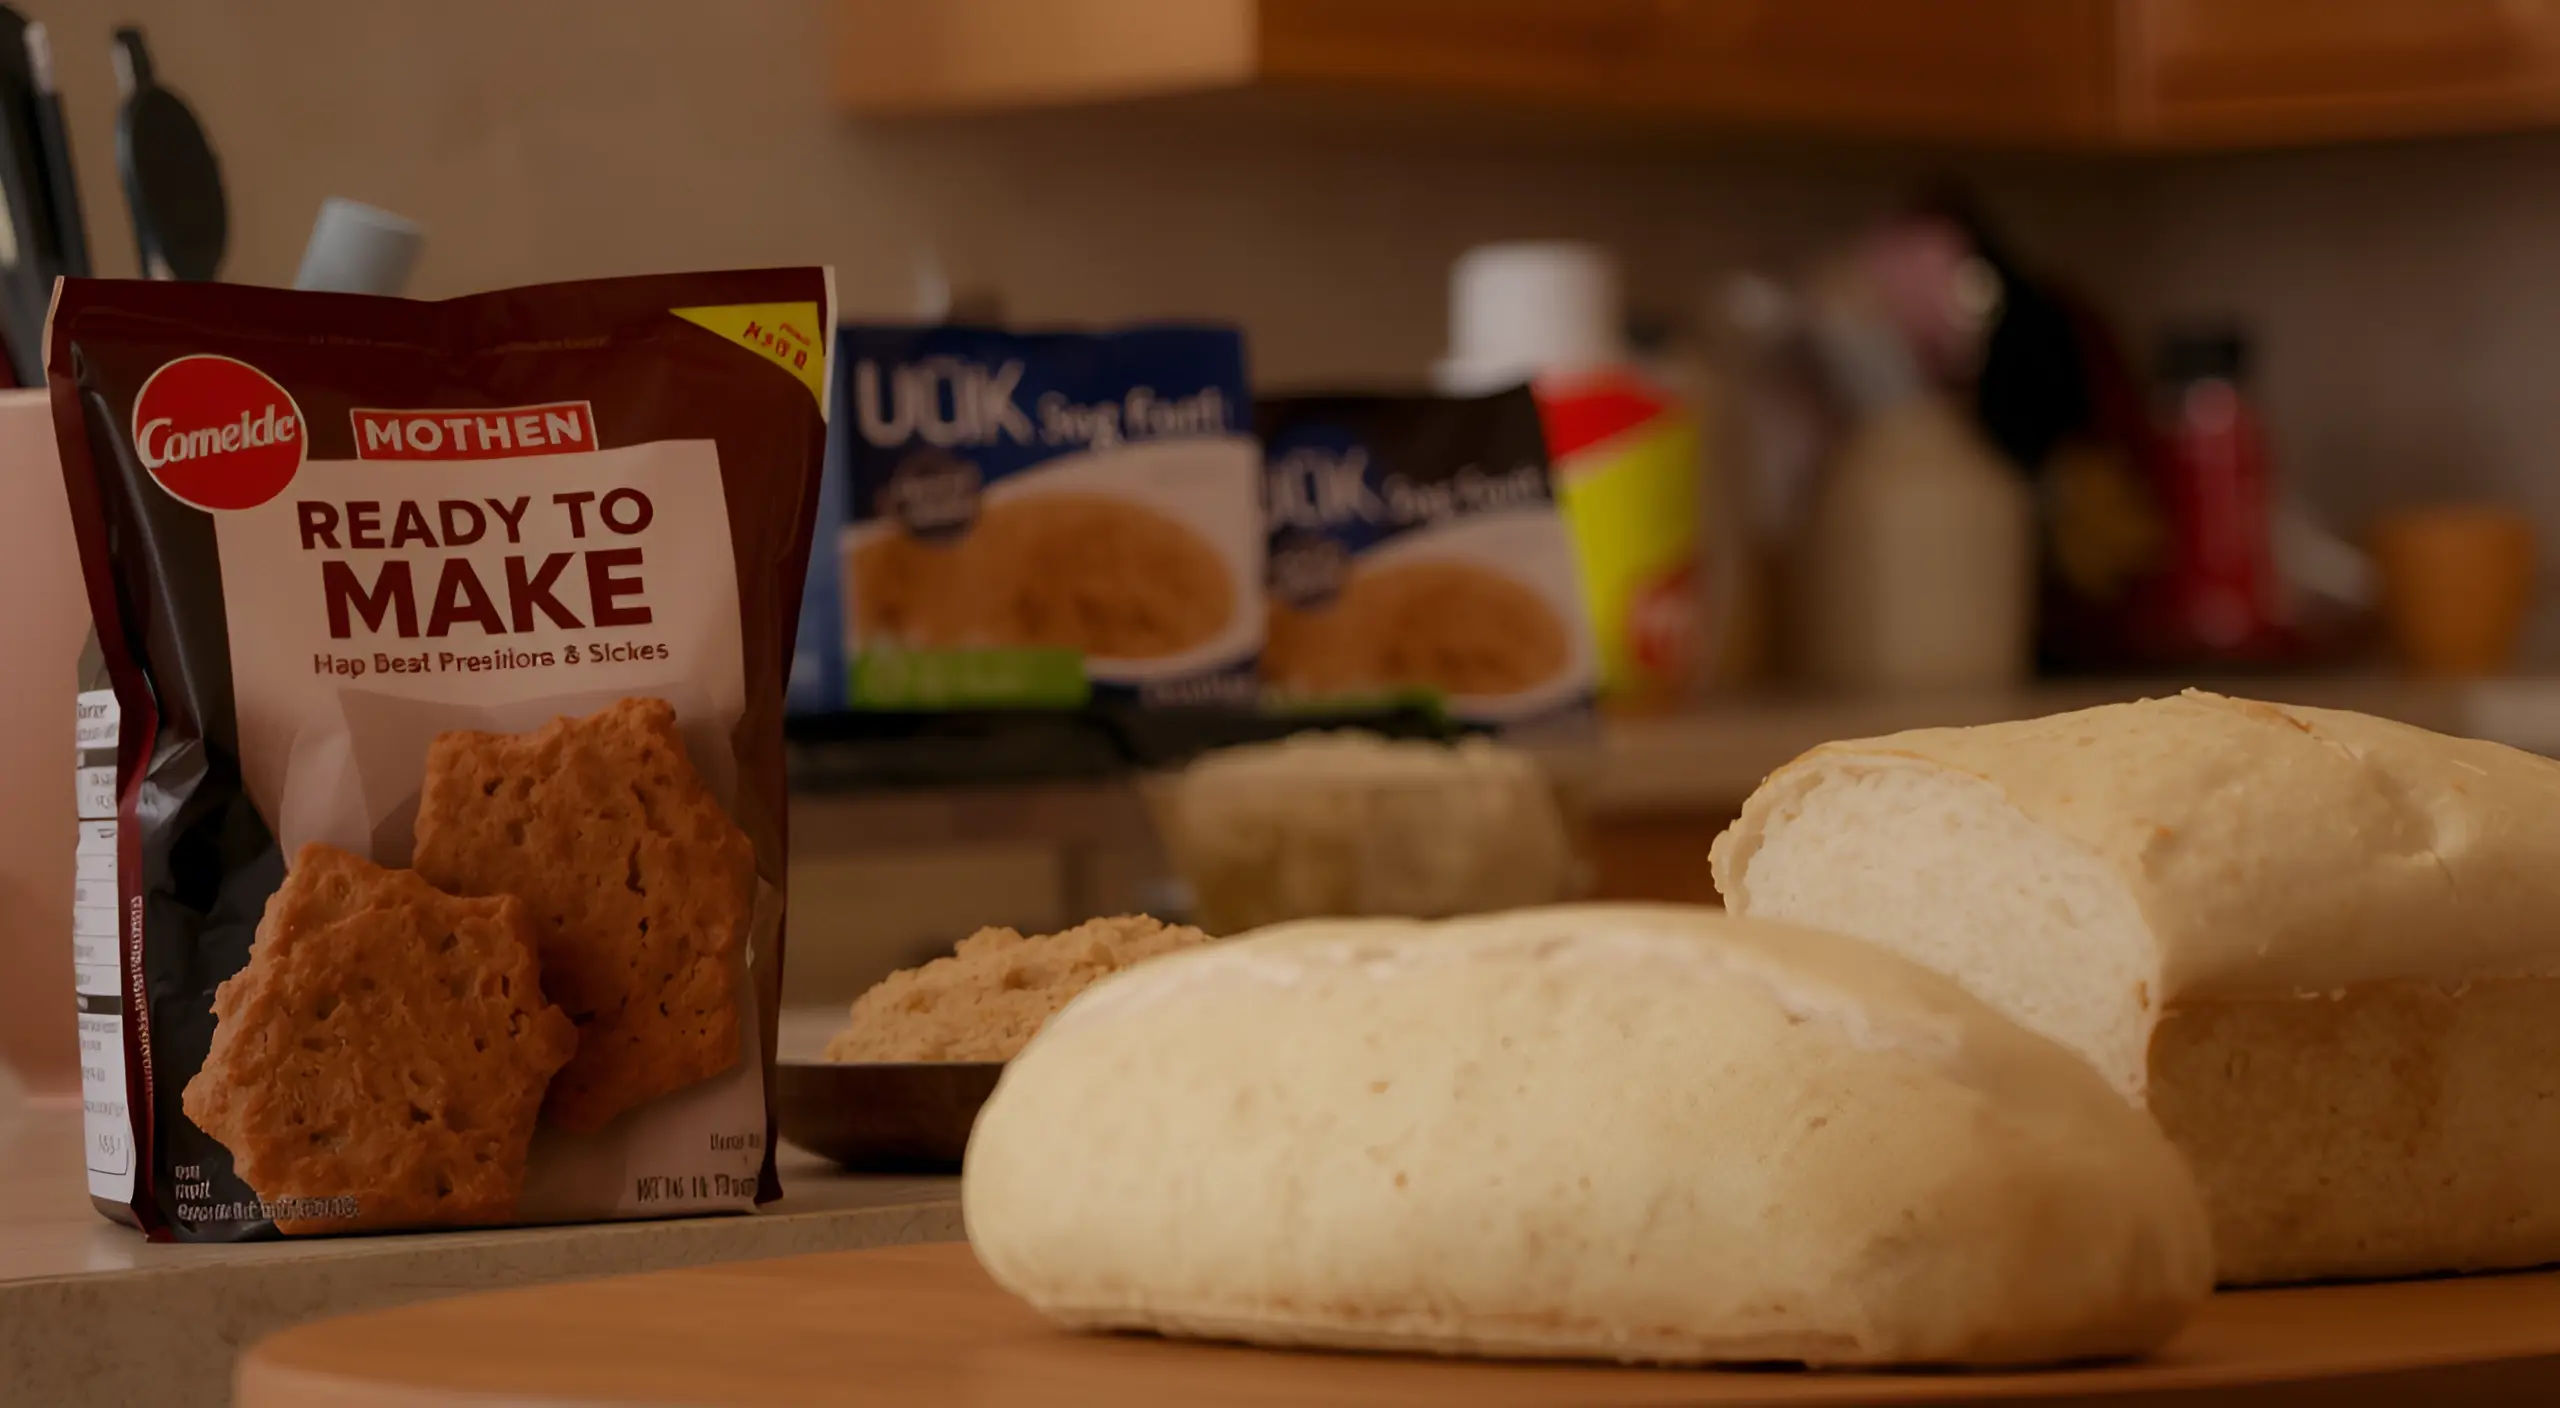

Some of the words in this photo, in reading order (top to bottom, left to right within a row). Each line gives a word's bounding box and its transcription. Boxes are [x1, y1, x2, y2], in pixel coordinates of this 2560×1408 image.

[363, 410, 583, 453] MOTHEN
[297, 497, 531, 550] READY
[553, 488, 654, 539] TO
[322, 547, 653, 639] MAKE
